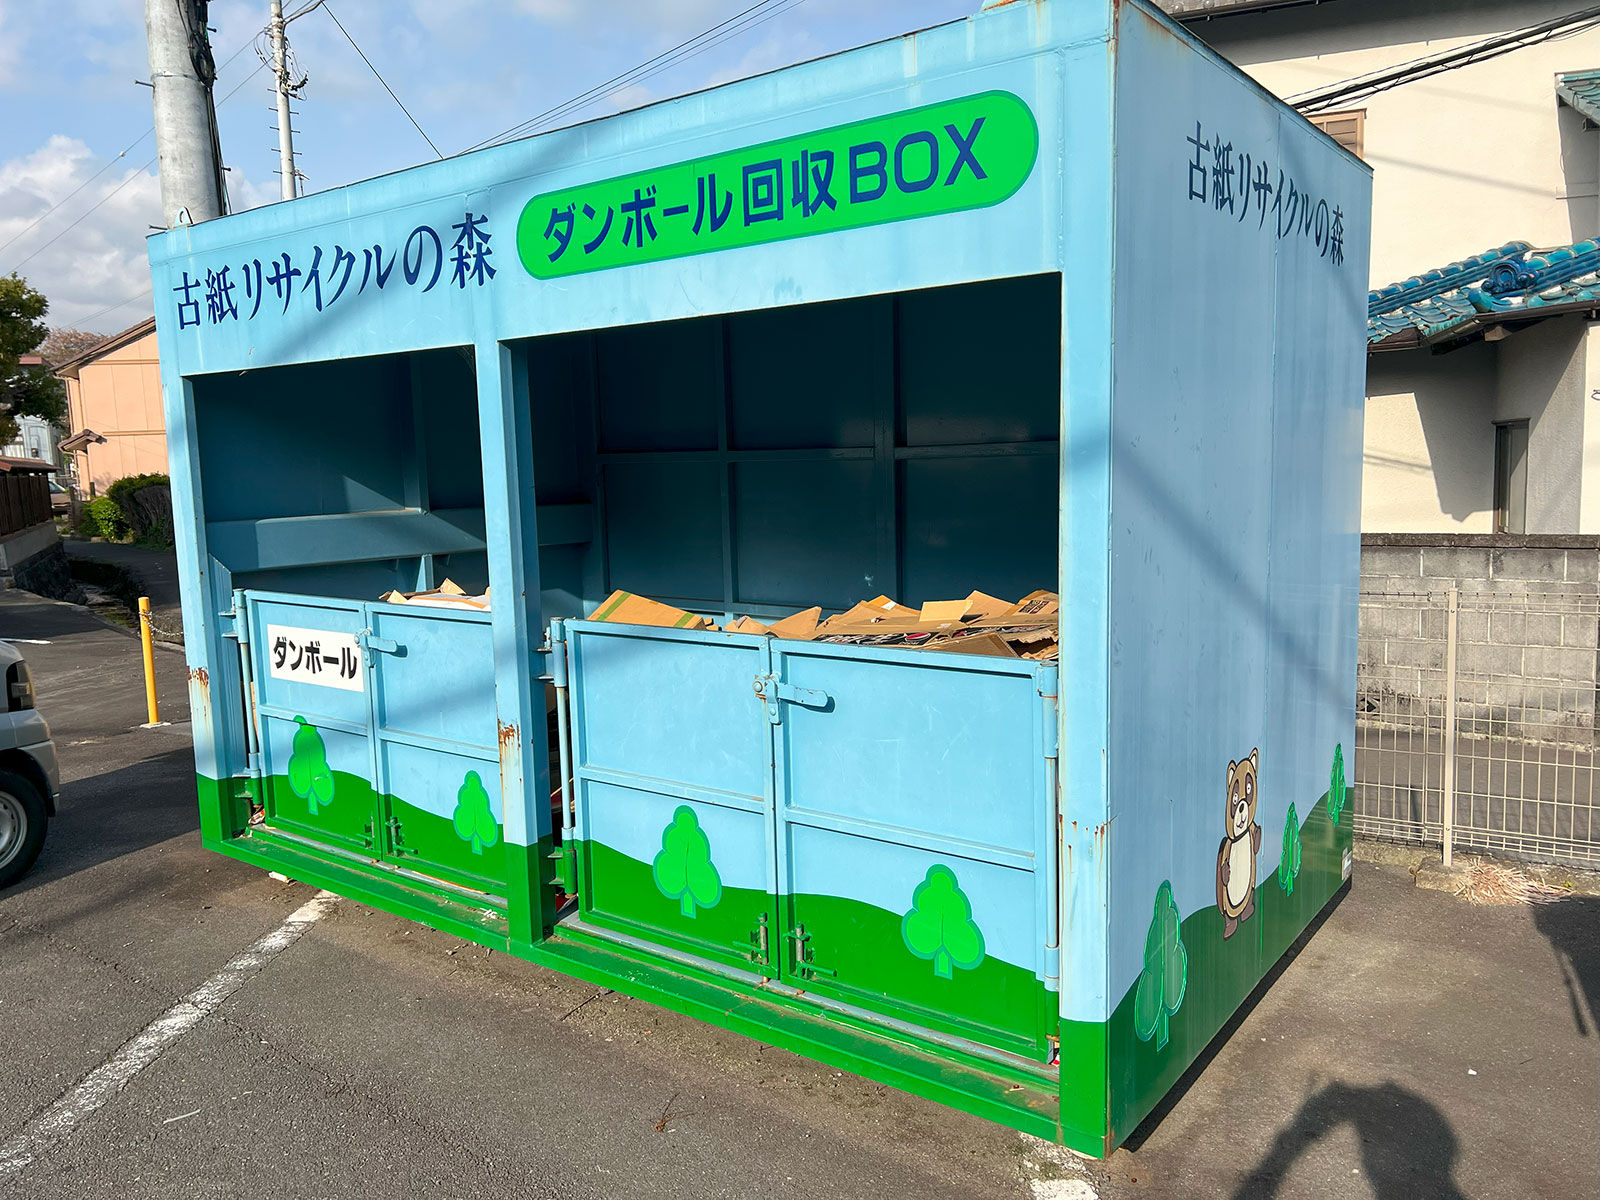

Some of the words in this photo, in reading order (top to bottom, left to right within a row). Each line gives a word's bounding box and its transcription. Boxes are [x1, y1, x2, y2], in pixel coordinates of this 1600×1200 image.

[543, 117, 988, 262] ダンボール回収BOX
[1186, 120, 1344, 266] 古紙リサイクルの森
[173, 213, 497, 330] 古紙リサイクルの森
[273, 636, 358, 679] ダンボール
